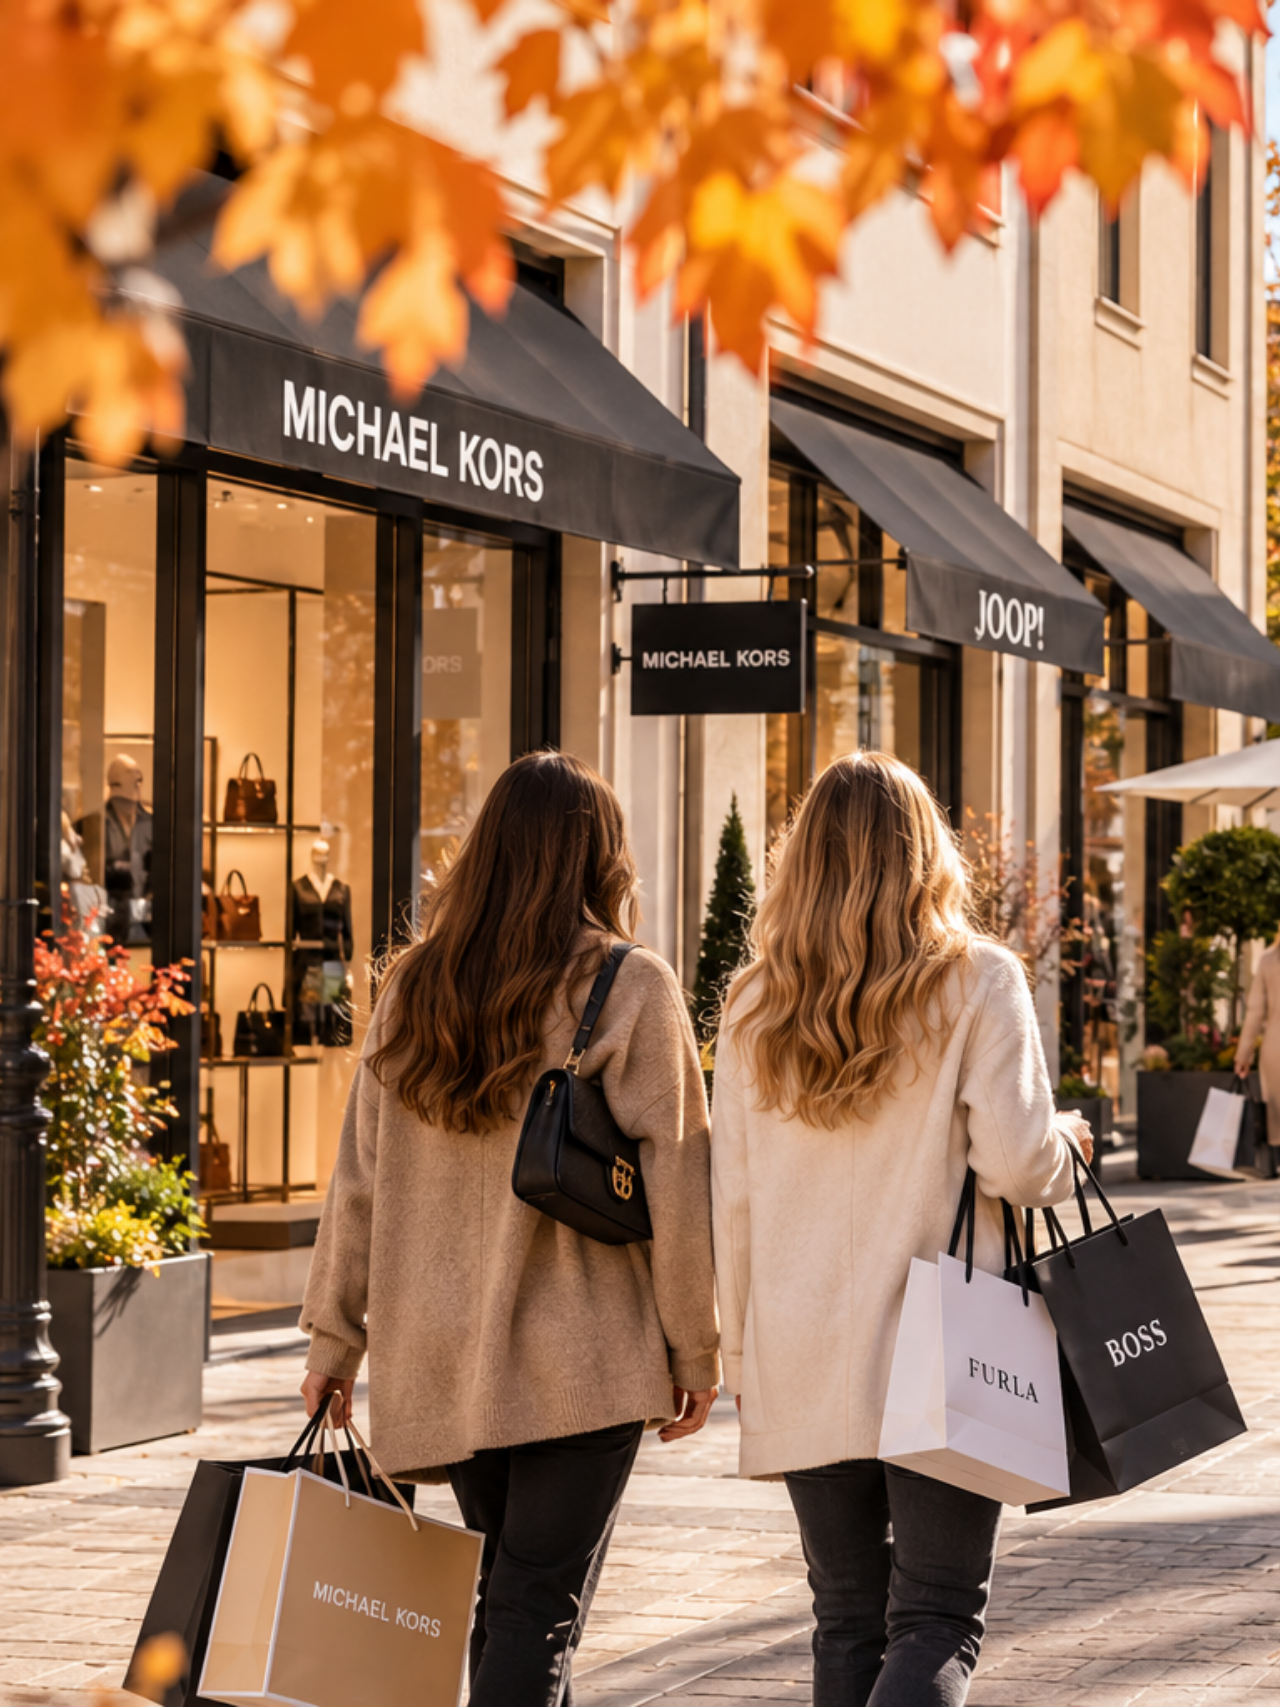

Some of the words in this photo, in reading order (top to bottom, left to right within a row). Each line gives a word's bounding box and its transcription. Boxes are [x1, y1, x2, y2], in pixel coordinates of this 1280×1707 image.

[283, 379, 449, 477] MICHAEL
[459, 430, 544, 502] KORS
[974, 589, 1044, 650] JOOP!
[642, 650, 731, 669] MICHAEL
[736, 649, 790, 667] KORS
[1106, 1320, 1167, 1367] BOSS
[968, 1358, 1039, 1404] FURLA
[312, 1581, 389, 1622] MICHAEL
[395, 1608, 441, 1638] KORS
